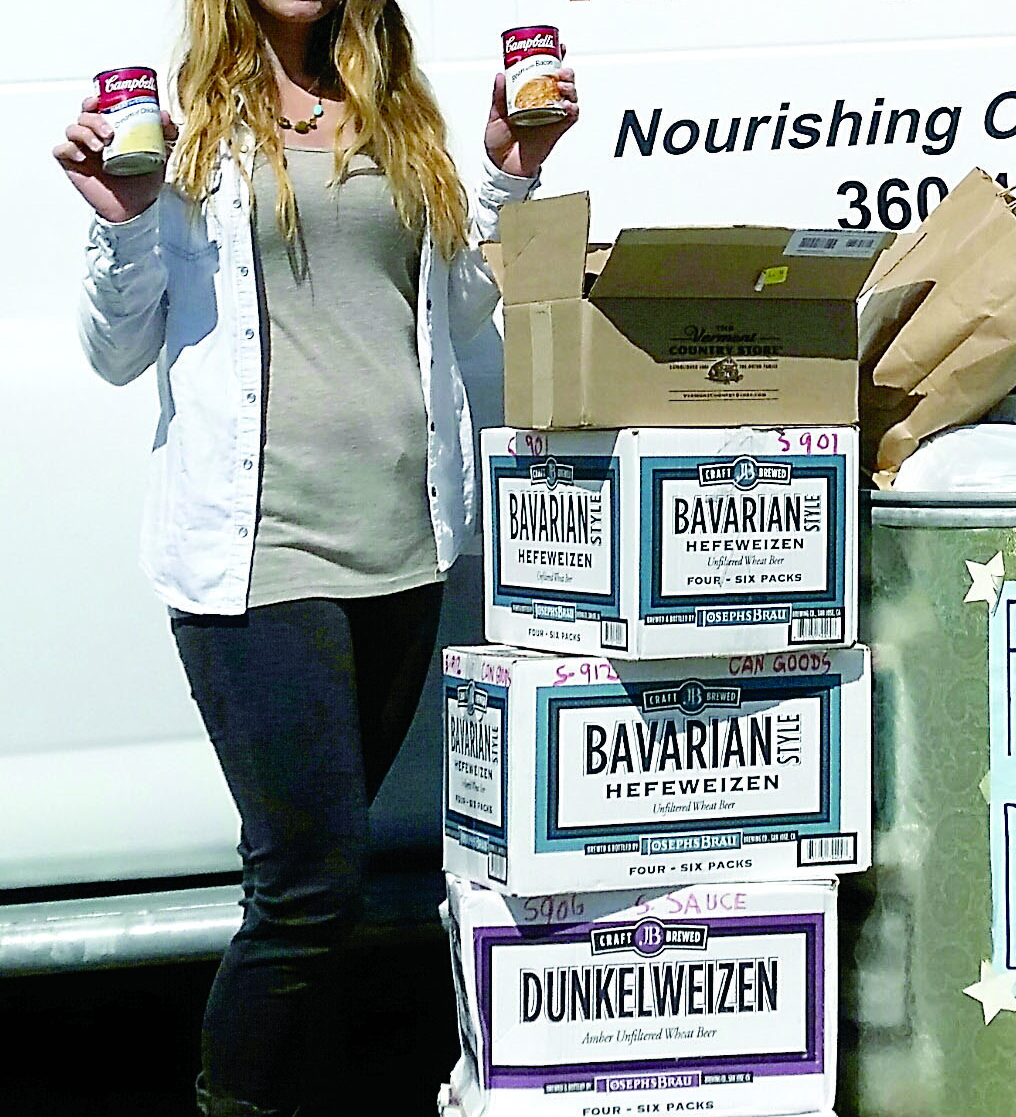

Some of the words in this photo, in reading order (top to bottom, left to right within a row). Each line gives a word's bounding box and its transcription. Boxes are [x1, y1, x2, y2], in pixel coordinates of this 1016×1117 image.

[614, 97, 963, 160] Nourishing
[705, 467, 732, 482] CRAFT
[757, 466, 788, 481] BREWED
[509, 492, 589, 545] BAVARIAN
[590, 493, 602, 547] STYLE
[674, 494, 801, 535] BAVARIAN
[804, 493, 822, 532] STYLE
[686, 538, 805, 553] HEFEWEIZEN
[518, 548, 593, 569] HEFEWEIZEN
[707, 555, 744, 570] Unfiltered
[744, 556, 768, 567] Wheat
[769, 556, 785, 566] Beer
[687, 576, 721, 586] FOUR
[735, 574, 756, 584] SIX
[760, 573, 803, 583] PACKS
[728, 655, 765, 677] CAN
[773, 652, 832, 675] GOODS
[648, 691, 678, 707] CRAFT
[706, 690, 737, 704] BREWED
[451, 715, 491, 762] BAVARIAN
[585, 716, 772, 776] BAVARIAN
[776, 712, 801, 766] STYLE
[605, 774, 780, 799] HEFEWEIZEN
[653, 800, 692, 817] Unfiltered
[692, 800, 718, 812] Wheat
[719, 800, 736, 810] Beer
[629, 865, 666, 875] FOUR
[680, 862, 702, 872] SIX
[708, 859, 753, 870] PACKS
[668, 891, 748, 916] SAUCE
[599, 930, 633, 948] CRAFT
[665, 928, 702, 945] BREWED
[521, 958, 779, 1023] DUNKELWEIZEN
[582, 1031, 615, 1045] Amber
[616, 1028, 663, 1046] Unfiltered
[664, 1027, 695, 1040] Wheat
[697, 1026, 718, 1038] Beer
[582, 1105, 622, 1117] FOUR
[636, 1103, 661, 1114] SIX
[666, 1100, 715, 1112] PACKS
